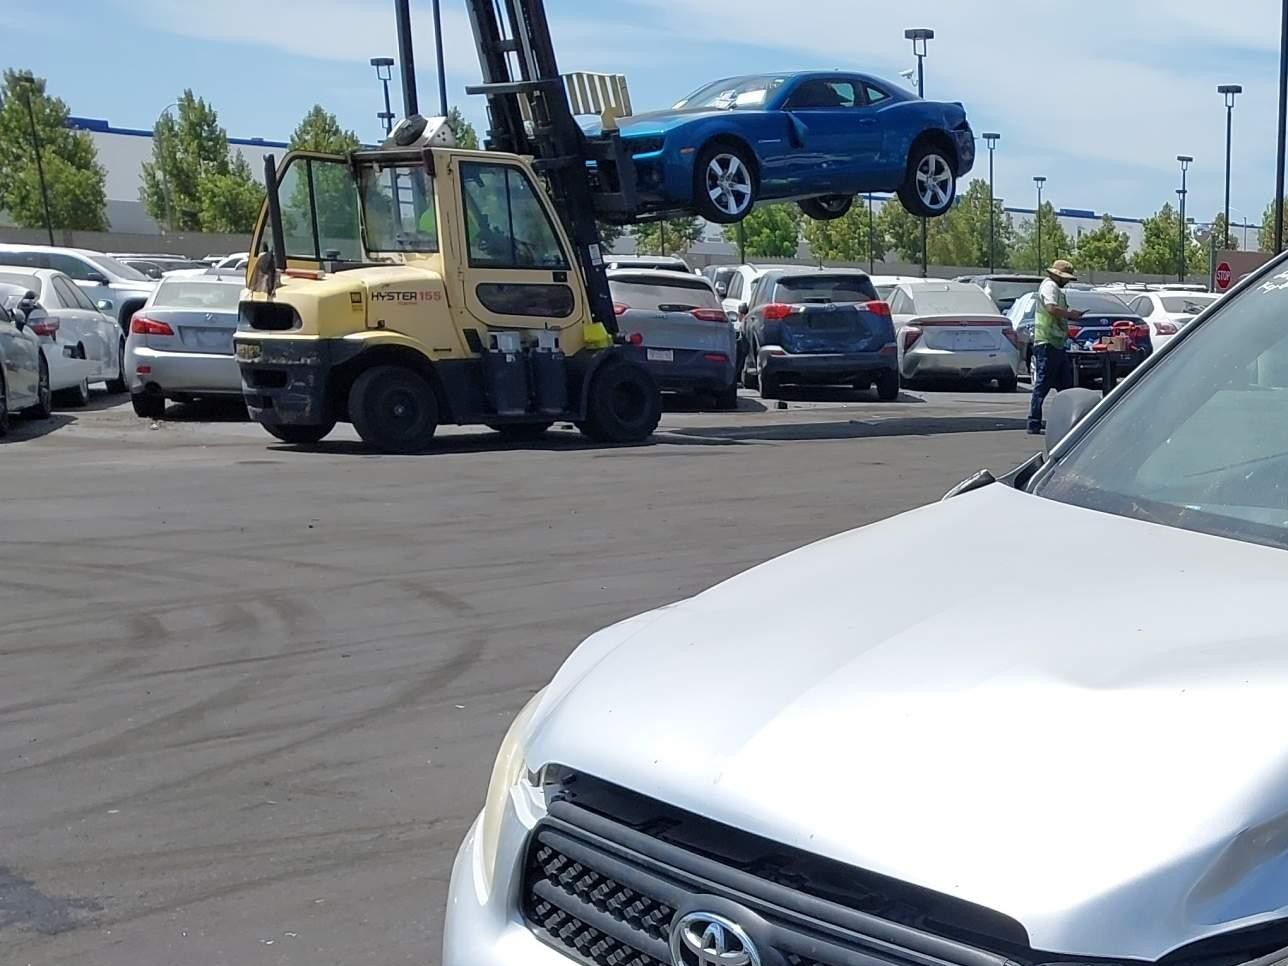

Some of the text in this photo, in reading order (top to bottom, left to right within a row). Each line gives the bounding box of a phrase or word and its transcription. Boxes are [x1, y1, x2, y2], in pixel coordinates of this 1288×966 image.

[1216, 270, 1231, 281] STOP
[371, 291, 442, 301] HYSTER 155
